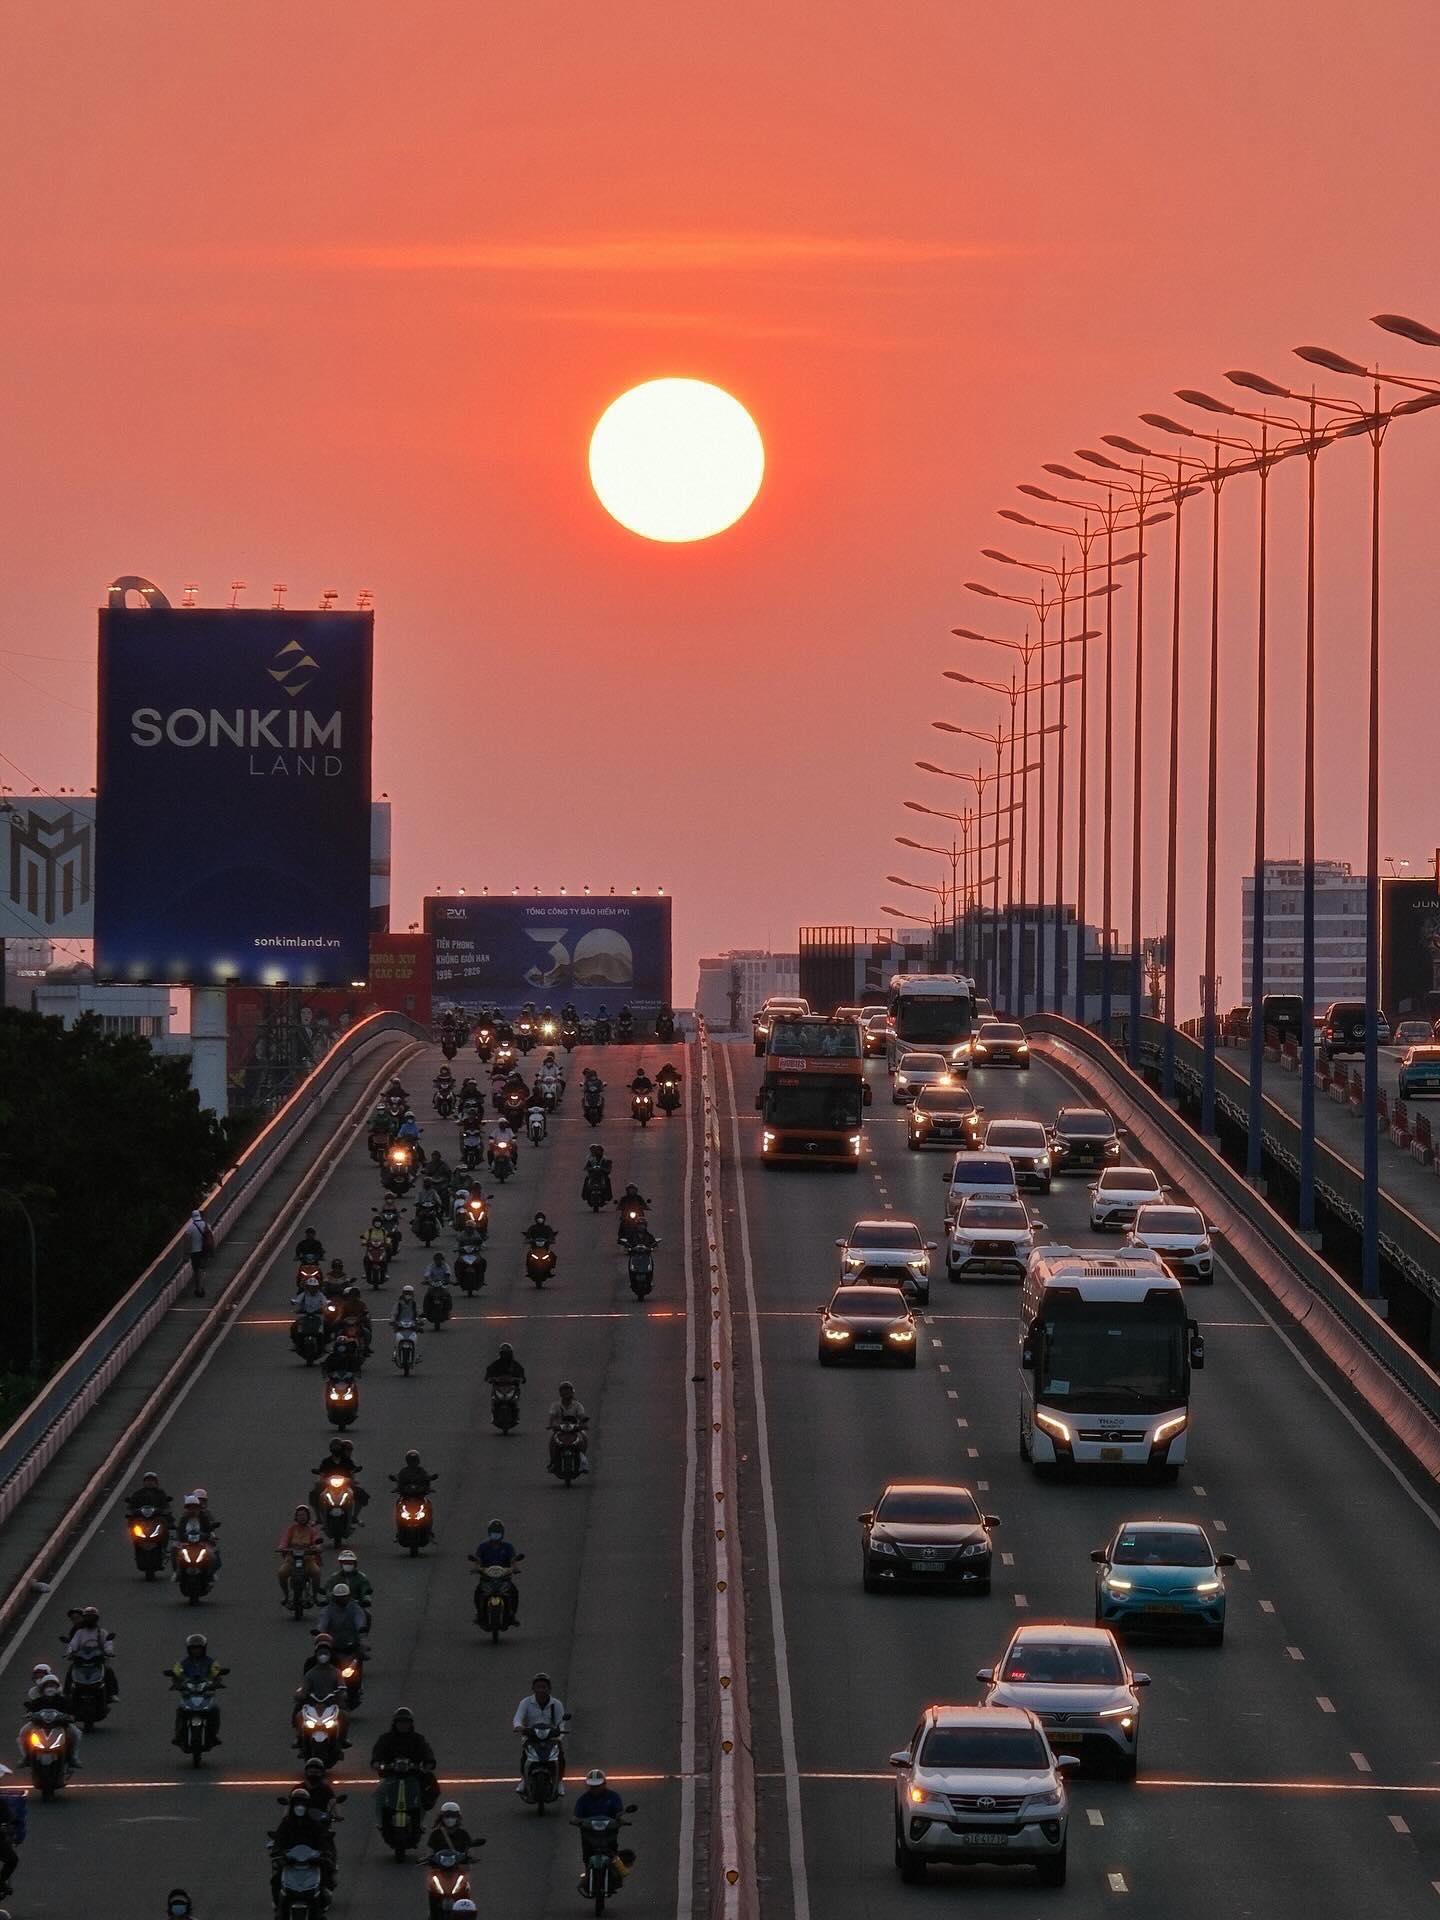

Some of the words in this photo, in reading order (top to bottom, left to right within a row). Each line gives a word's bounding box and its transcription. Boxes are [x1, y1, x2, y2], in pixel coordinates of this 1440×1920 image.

[130, 707, 343, 749] SONKIM
[249, 754, 343, 777] LAND
[447, 908, 466, 916] PVI
[547, 906, 568, 916] CÔNG
[617, 908, 630, 916] PVI
[254, 936, 341, 948] sonkimland.vn
